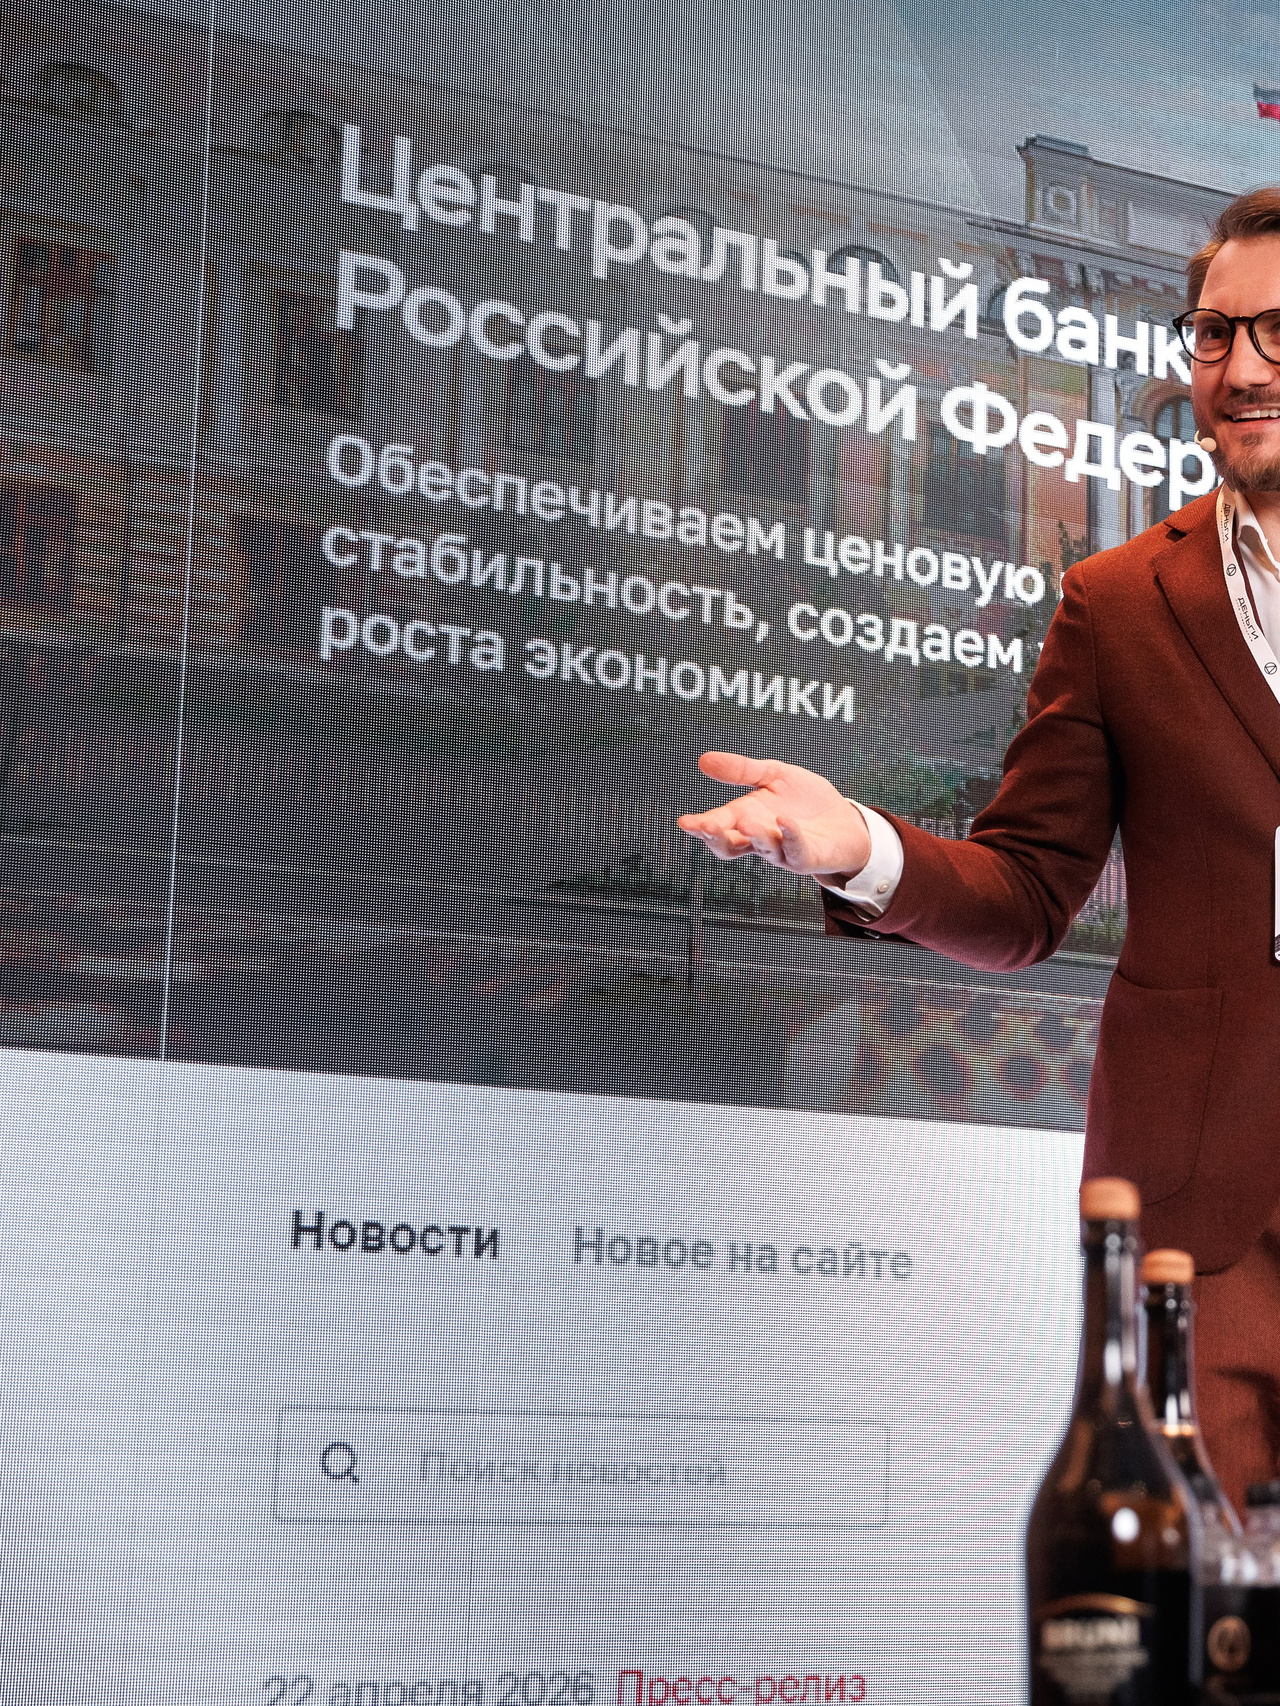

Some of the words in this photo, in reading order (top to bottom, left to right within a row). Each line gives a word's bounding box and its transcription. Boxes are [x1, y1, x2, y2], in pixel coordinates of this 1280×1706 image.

[339, 121, 979, 339] Центральный
[1004, 277, 1192, 386] банк
[336, 249, 919, 440] Российской
[941, 380, 1223, 512] Федер
[327, 432, 786, 560] Обеспечиваем
[804, 526, 1046, 608] ценовую
[322, 521, 767, 644] стабильность,
[787, 596, 1023, 673] создаем
[1237, 597, 1259, 640] ДЕНЬГИ
[319, 605, 505, 671] роста
[525, 642, 856, 724] экономики
[290, 1209, 500, 1261] Новости
[572, 1225, 715, 1268] Новое
[728, 1236, 778, 1275] на
[791, 1234, 914, 1282] сайте
[418, 1450, 541, 1485] Поиск
[550, 1454, 727, 1486] новостей
[263, 1672, 313, 1706] 22
[329, 1676, 484, 1706] апреля
[496, 1670, 595, 1706] 2026
[616, 1667, 867, 1706] Пресс-релиз
